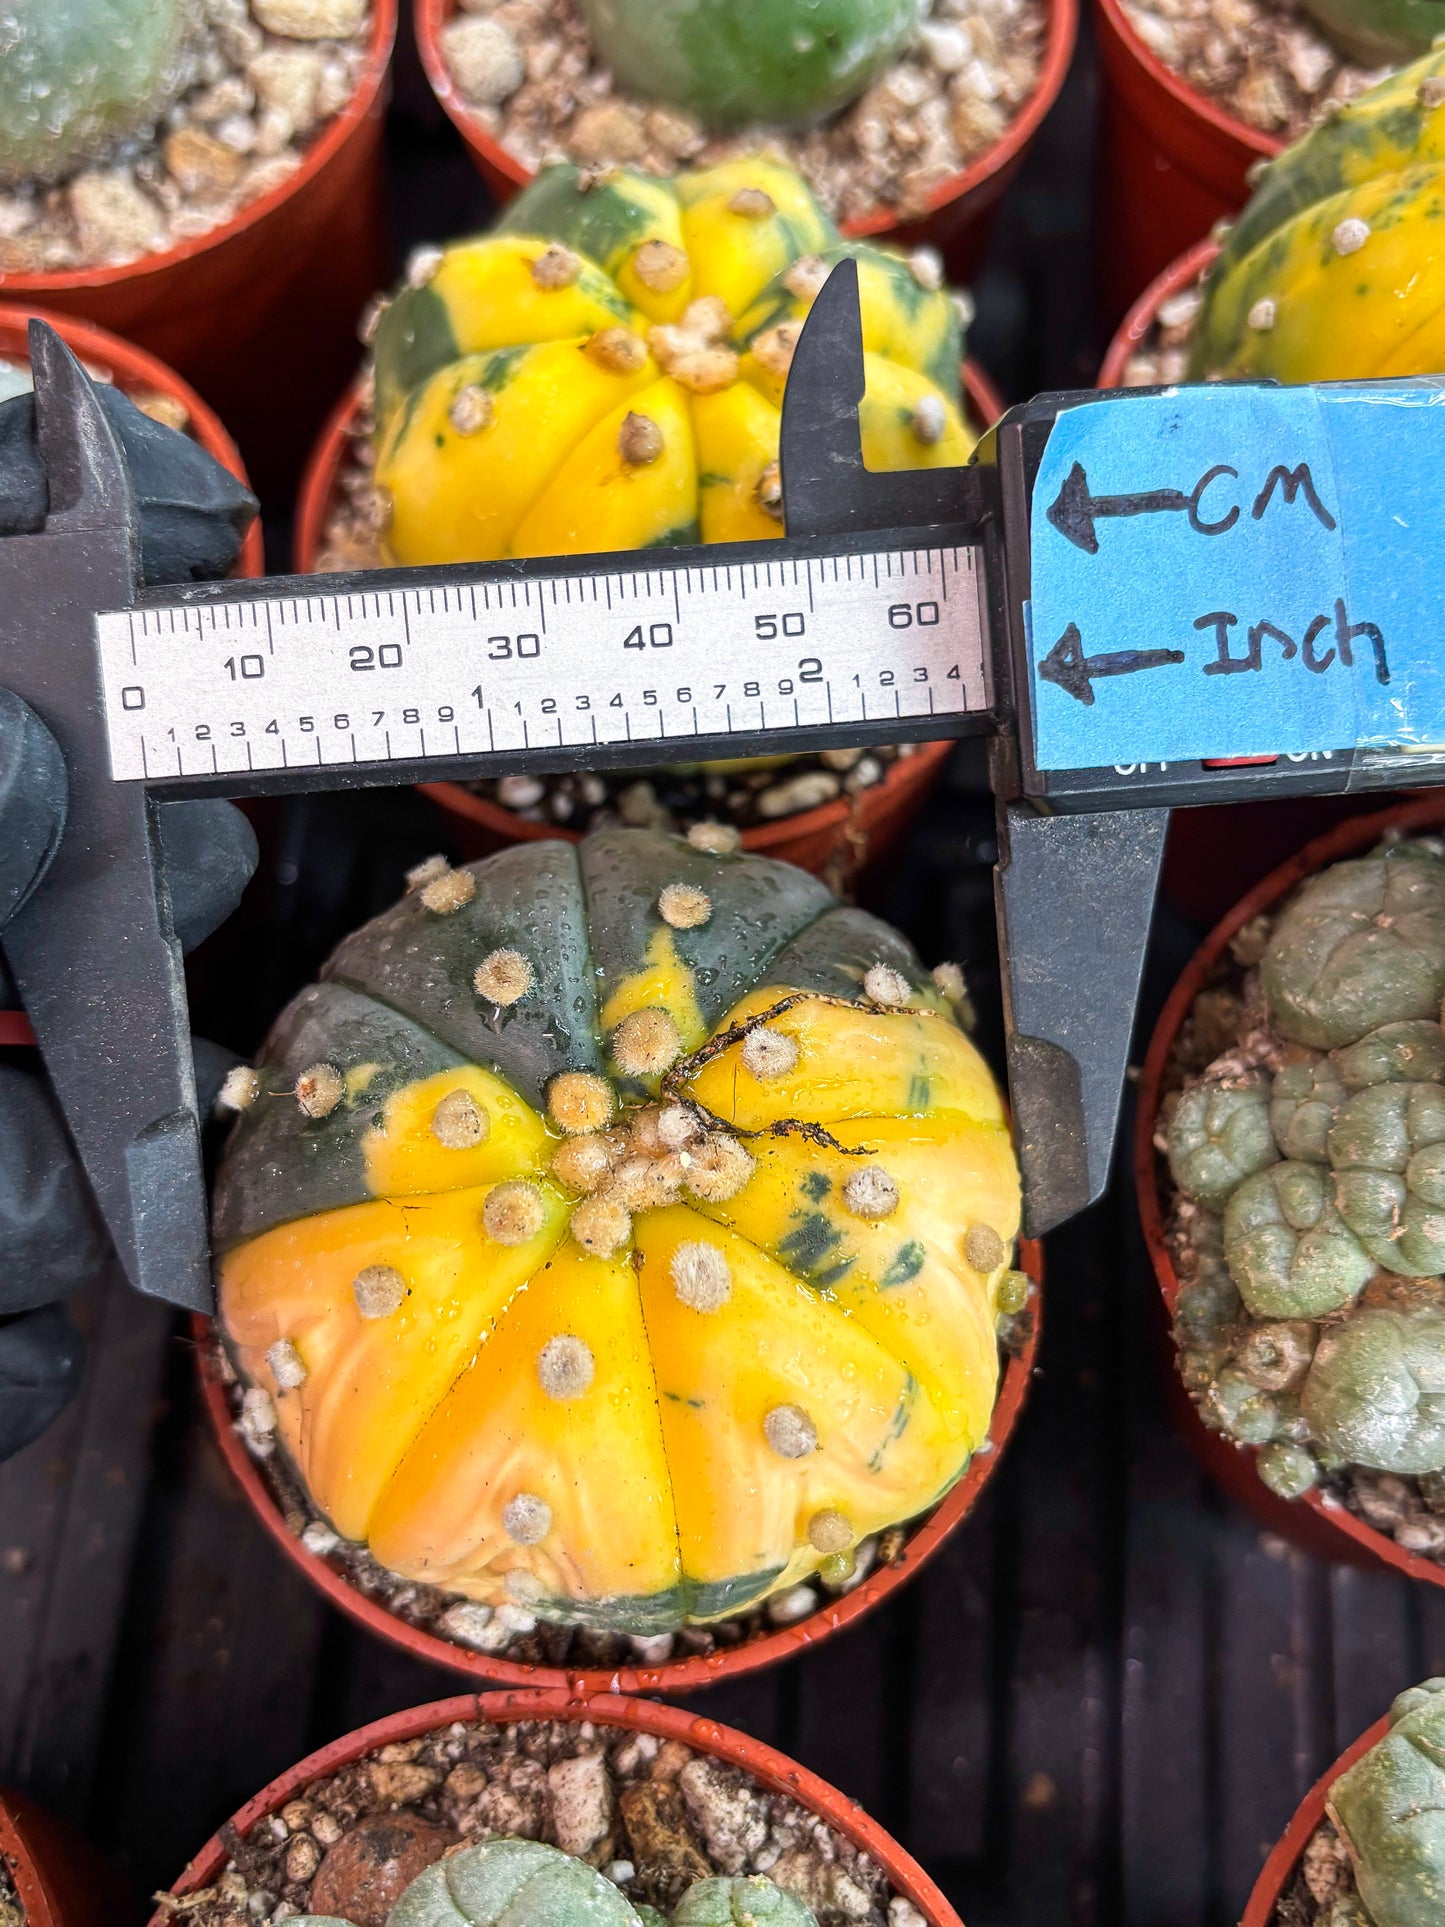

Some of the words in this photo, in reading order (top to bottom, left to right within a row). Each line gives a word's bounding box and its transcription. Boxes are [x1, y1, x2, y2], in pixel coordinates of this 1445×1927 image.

[1188, 463, 1336, 536] CM
[121, 686, 145, 711] 0
[223, 654, 264, 681] 10
[349, 643, 403, 672] 20
[487, 633, 541, 660] 30
[623, 623, 673, 651] 40
[754, 612, 805, 640] 50
[887, 601, 940, 630] 60
[1193, 598, 1390, 685] Inch
[195, 724, 211, 741] 2
[230, 721, 246, 737] 3
[265, 719, 280, 735] 4
[299, 716, 314, 733] 5
[334, 713, 350, 730] 6
[371, 711, 385, 727] 7
[402, 708, 420, 724] 8
[437, 705, 454, 723] 9
[540, 698, 557, 714] 2
[575, 695, 591, 710] 3
[609, 692, 624, 708] 4
[643, 689, 657, 706] 5
[676, 686, 692, 703] 6
[713, 684, 726, 701] 7
[743, 681, 761, 697] 8
[778, 678, 794, 695] 9
[798, 657, 824, 683] 2
[879, 670, 895, 686] 2
[913, 667, 929, 683] 3
[946, 664, 961, 681] 4
